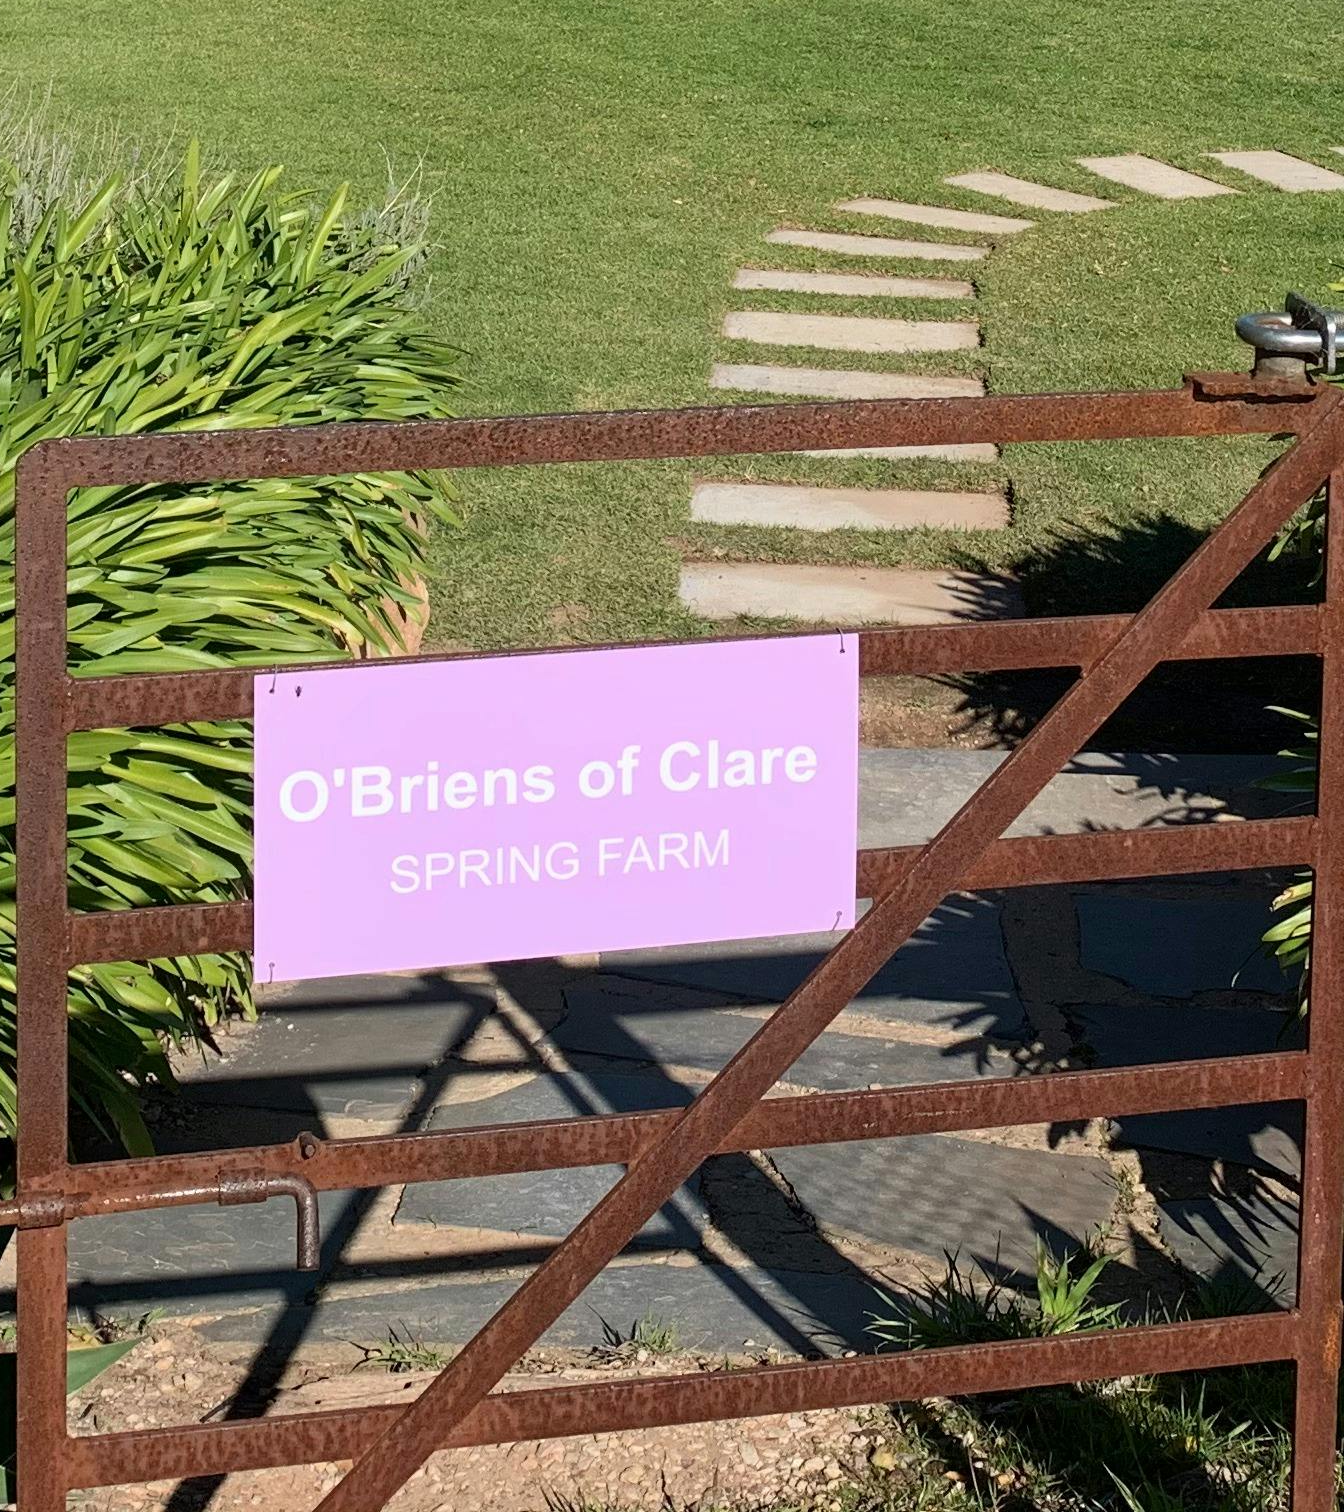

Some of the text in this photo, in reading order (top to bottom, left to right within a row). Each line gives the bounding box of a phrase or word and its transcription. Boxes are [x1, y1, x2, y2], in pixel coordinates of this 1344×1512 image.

[278, 738, 819, 824] O'Briens of Clare
[389, 828, 730, 895] SPRING FARM
